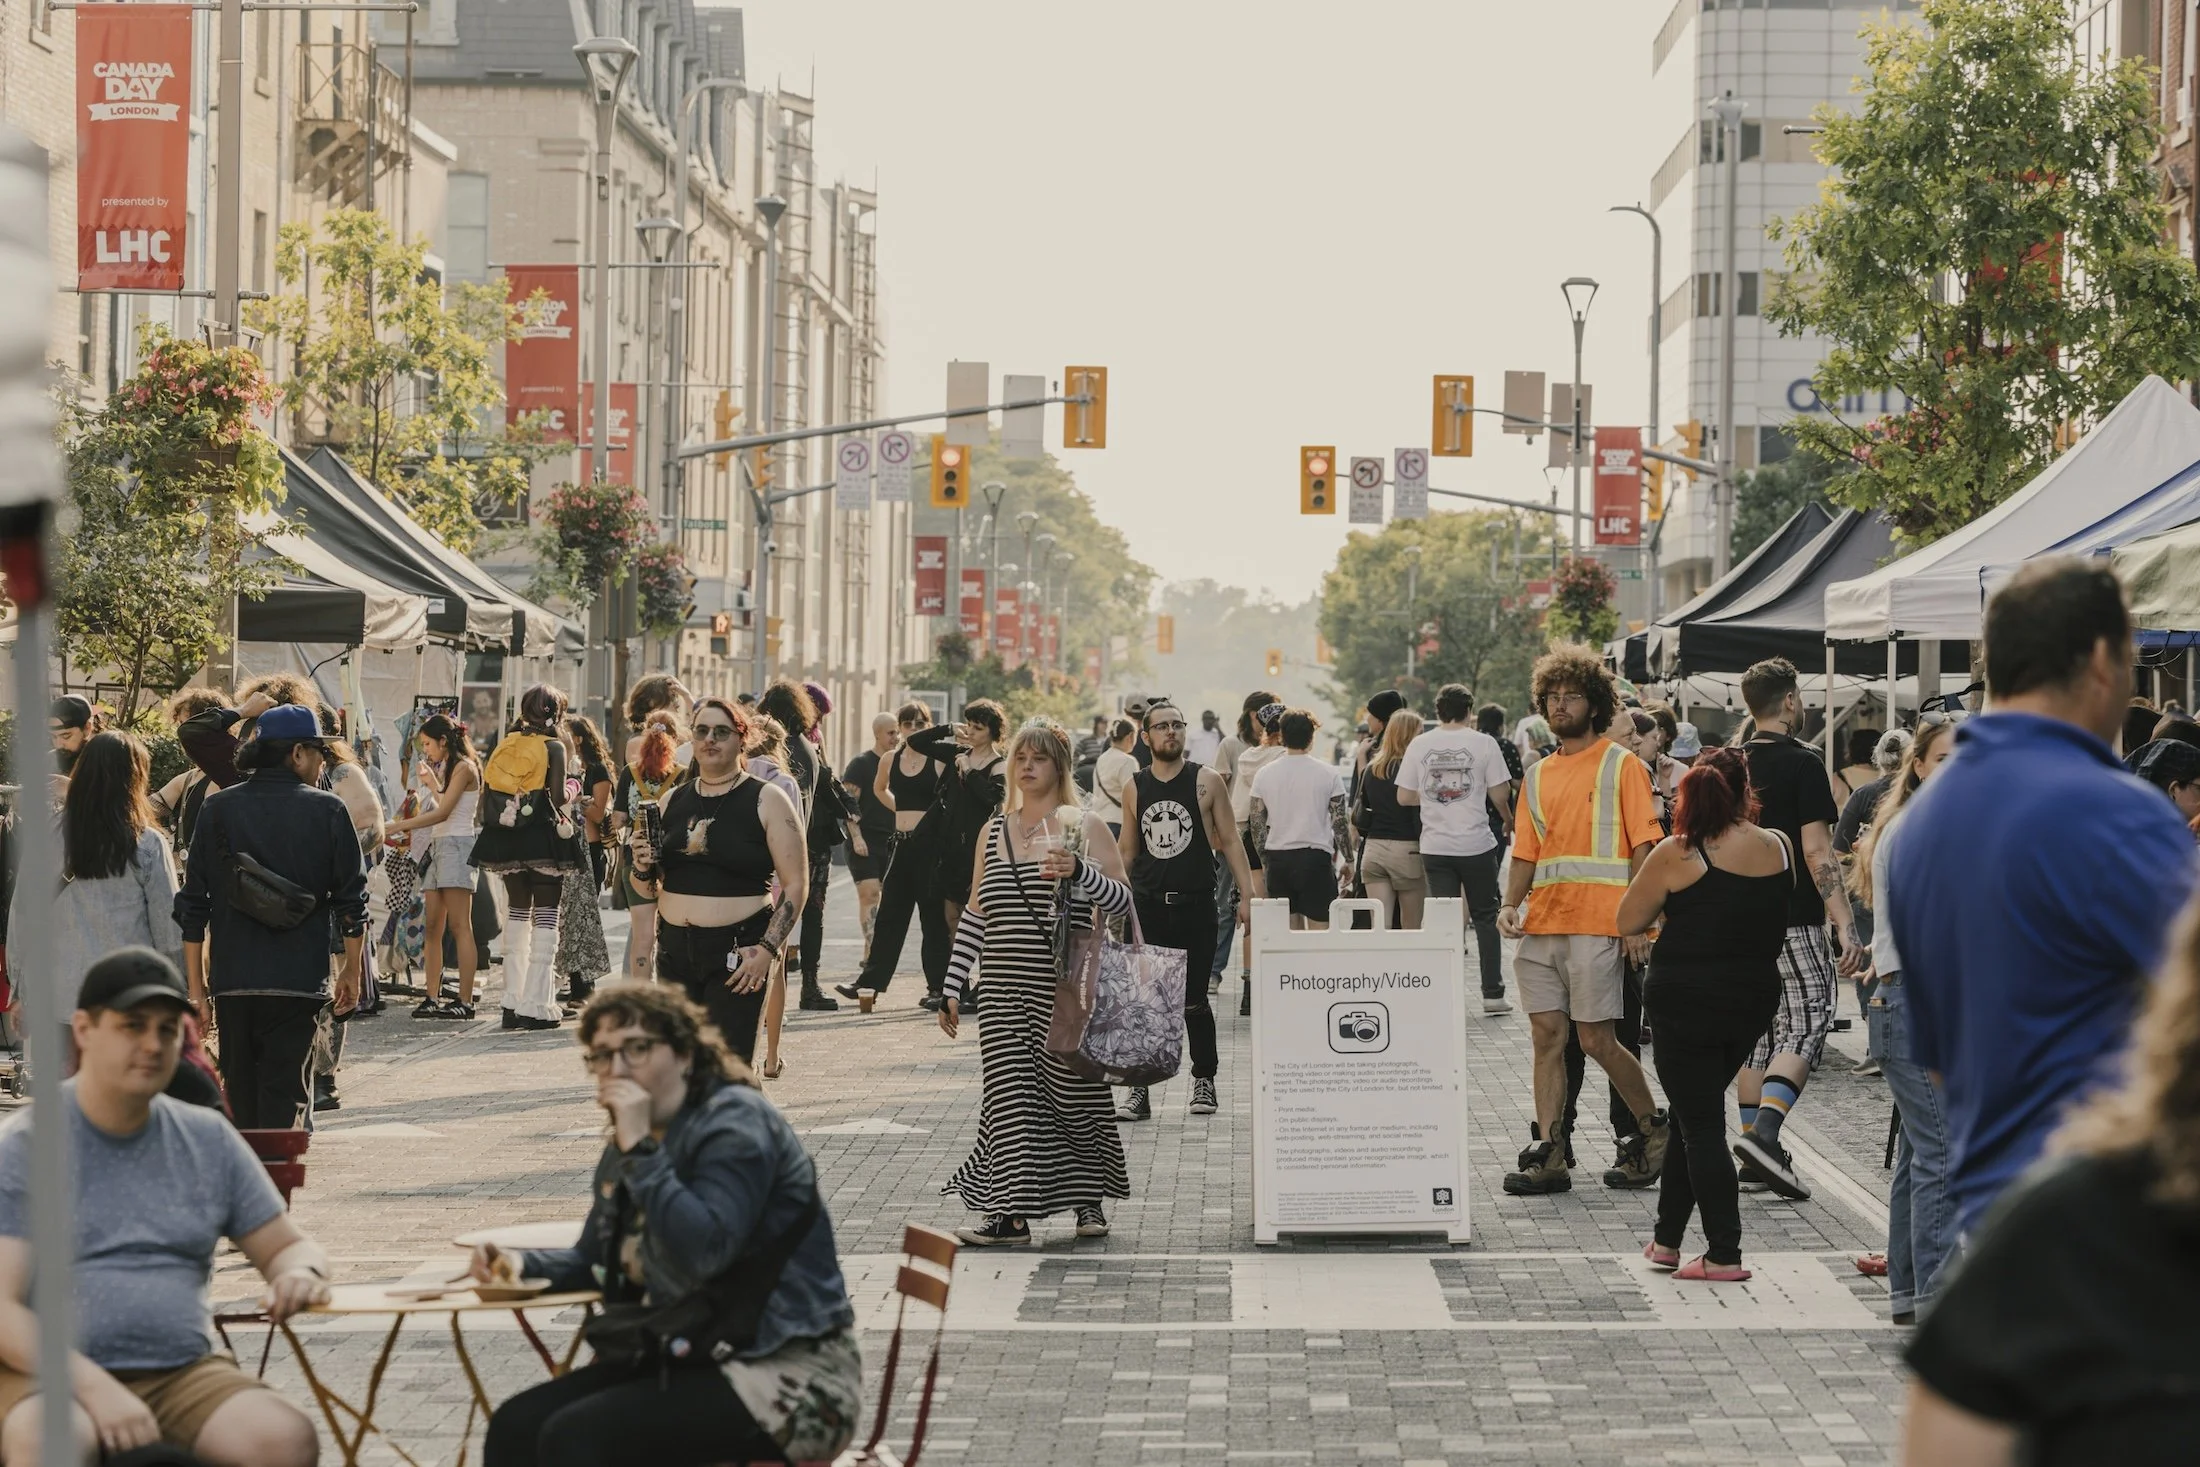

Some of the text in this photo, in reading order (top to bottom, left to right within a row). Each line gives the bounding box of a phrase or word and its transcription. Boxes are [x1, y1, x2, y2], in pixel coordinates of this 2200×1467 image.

[93, 62, 175, 78] CANADA
[105, 77, 164, 101] DAY
[110, 107, 160, 116] LONDON
[101, 197, 170, 208] presented by
[96, 230, 171, 263] LHC
[1599, 517, 1631, 534] LHC
[1142, 801, 1190, 826] PROGRESS
[1079, 959, 1091, 1010] value village
[1280, 972, 1431, 994] Photography/Video
